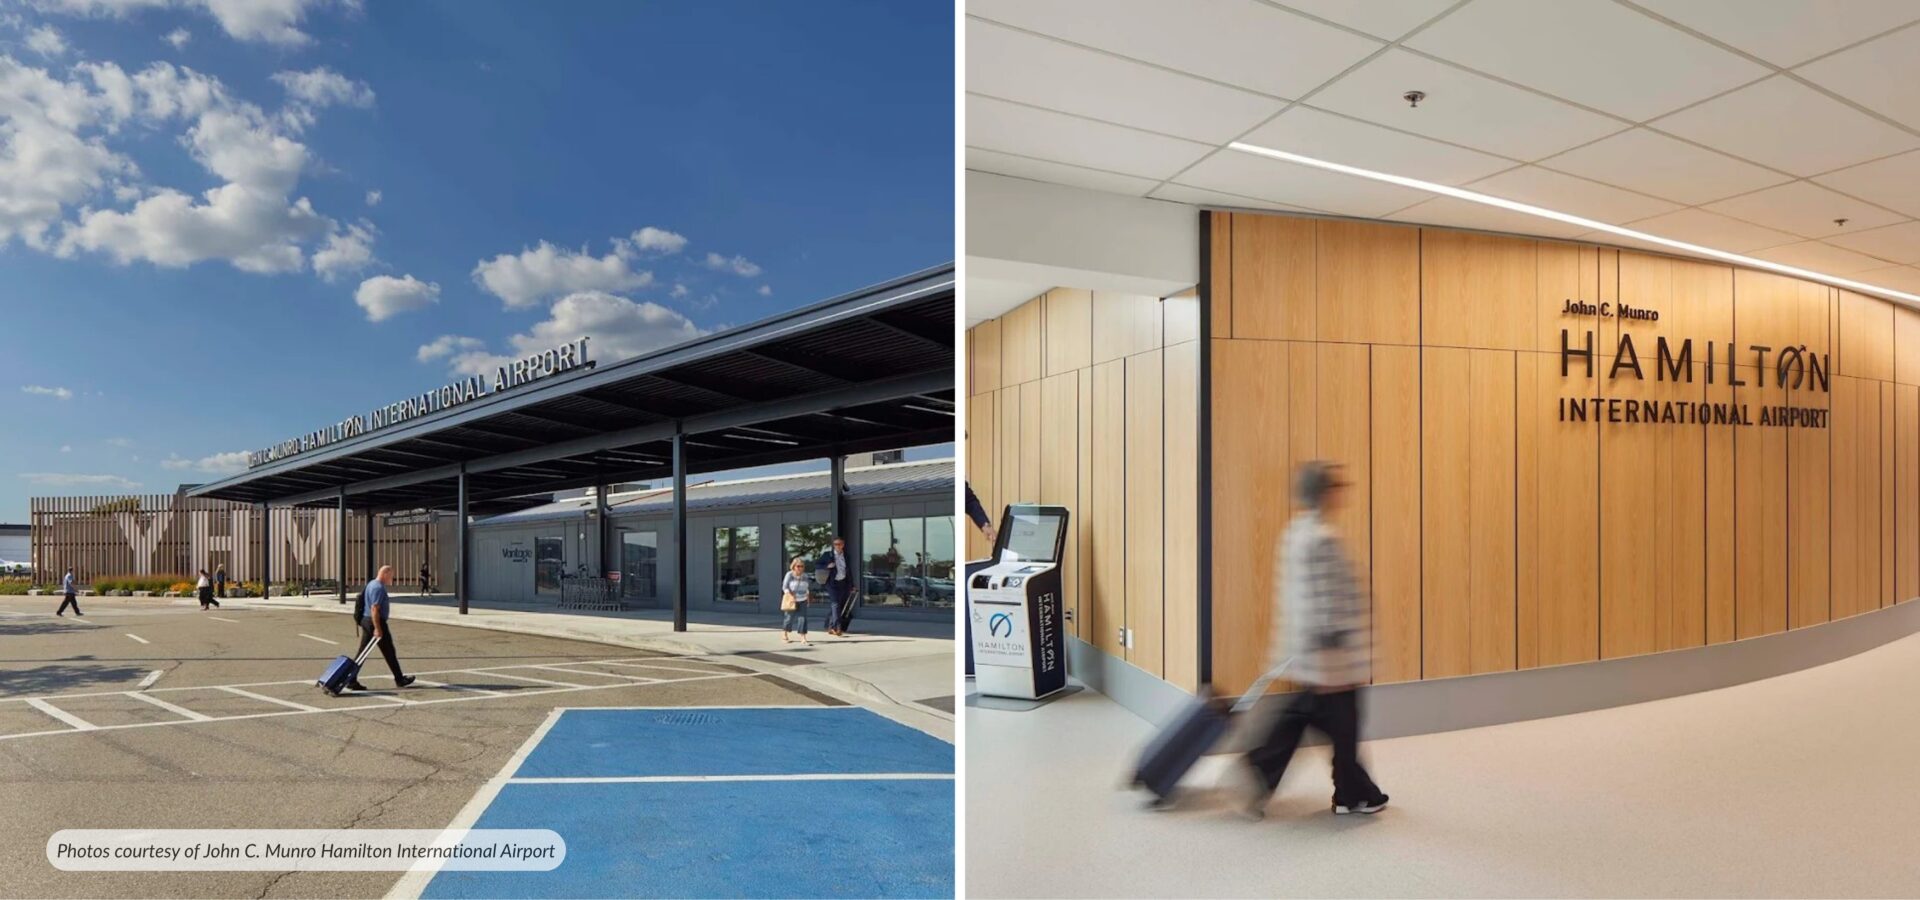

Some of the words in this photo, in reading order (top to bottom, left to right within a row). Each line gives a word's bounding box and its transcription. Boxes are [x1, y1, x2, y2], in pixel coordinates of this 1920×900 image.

[1562, 299, 1597, 316] John
[1600, 302, 1614, 318] C.
[1618, 303, 1659, 321] Munro
[1561, 328, 1829, 393] HAMILTON
[271, 438, 299, 460] MUNRO
[303, 414, 364, 451] HAMILTON
[369, 373, 486, 430] INTERNATIONAL
[493, 336, 590, 393] AIRPORT
[1559, 397, 1753, 426] INTERNATIONAL
[1759, 406, 1829, 429] AIRPORT
[114, 507, 341, 581] YHM
[978, 642, 1025, 651] HAMILTON
[1043, 592, 1055, 671] HAMILTON
